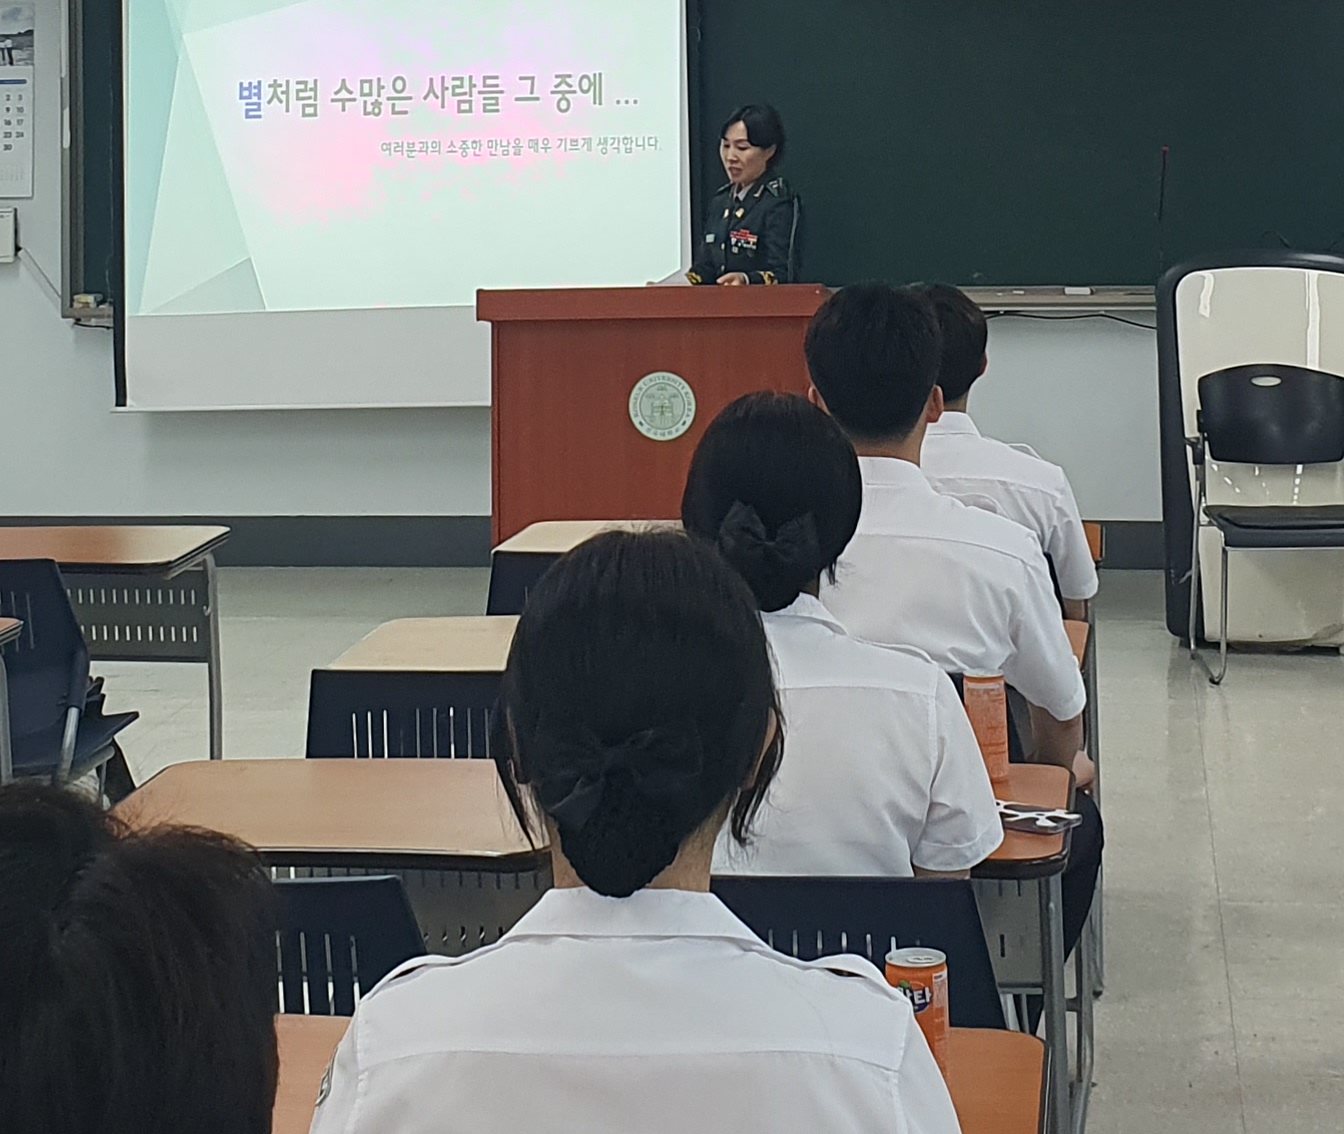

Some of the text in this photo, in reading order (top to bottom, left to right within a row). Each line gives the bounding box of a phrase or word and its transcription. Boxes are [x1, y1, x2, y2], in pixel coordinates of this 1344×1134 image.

[238, 78, 319, 119] 별처럼
[330, 75, 413, 117] 수많은
[422, 74, 505, 114] 사람들
[513, 75, 541, 102] 그
[549, 72, 603, 114] 중에
[380, 139, 442, 158] 여러분과의
[446, 139, 483, 158] 소중한
[486, 137, 524, 157] 만남을
[527, 136, 552, 153] 매우
[596, 135, 662, 155] 생각합니다.
